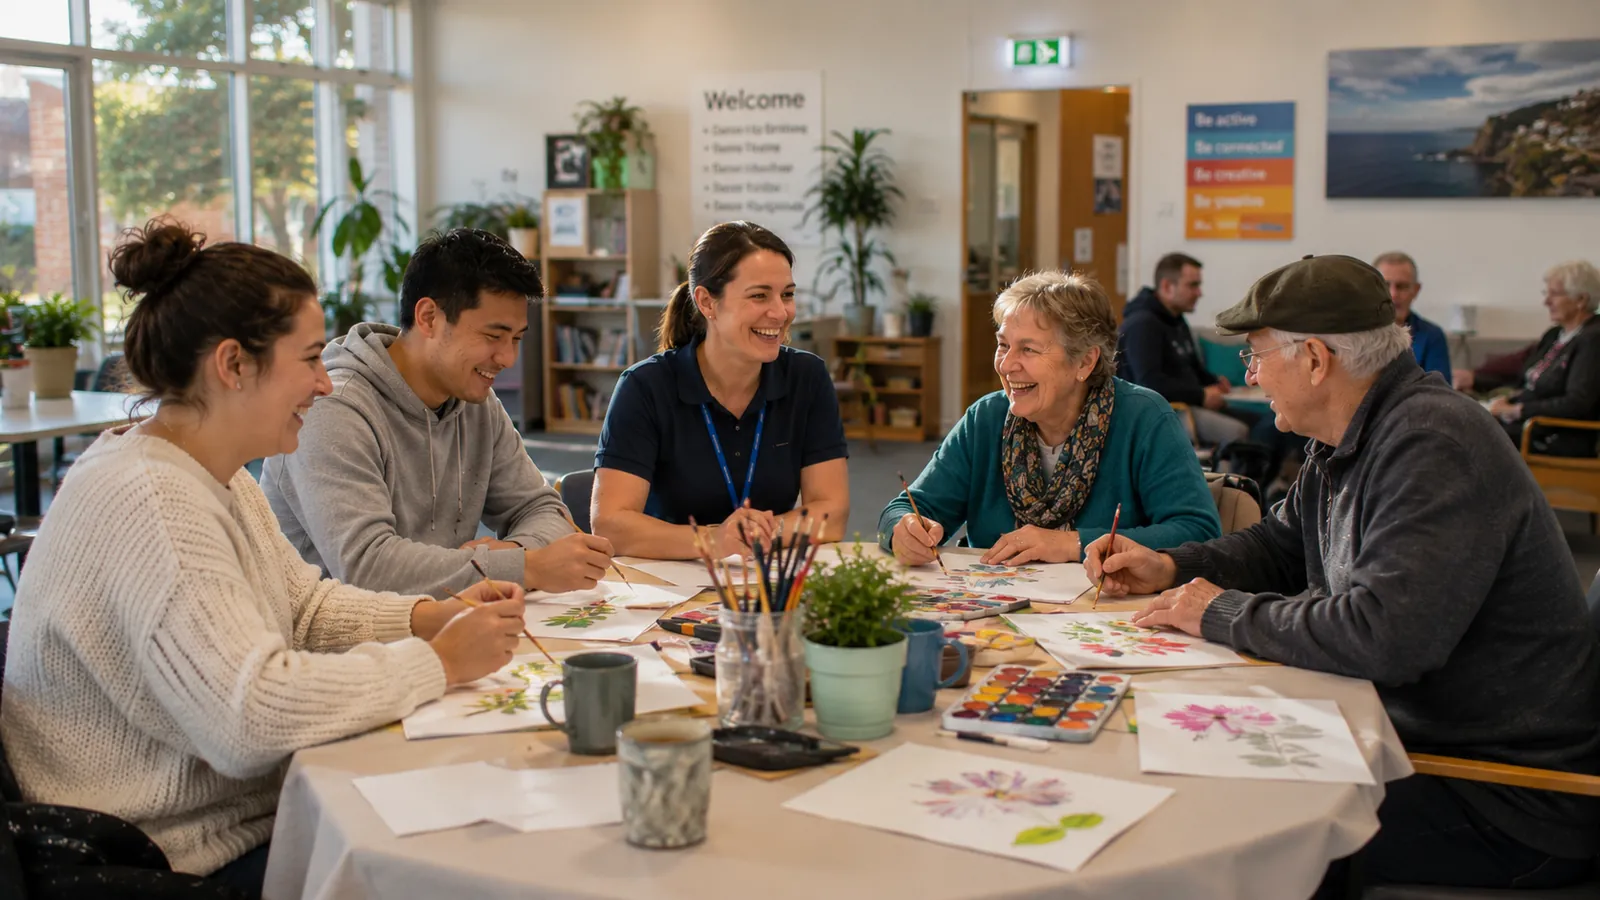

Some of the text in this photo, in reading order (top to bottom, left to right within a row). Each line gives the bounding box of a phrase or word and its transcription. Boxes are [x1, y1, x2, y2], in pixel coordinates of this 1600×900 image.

[704, 89, 806, 111] Welcome
[1195, 112, 1257, 127] Be active
[1195, 139, 1285, 154] Be connected
[1214, 168, 1267, 182] creative
